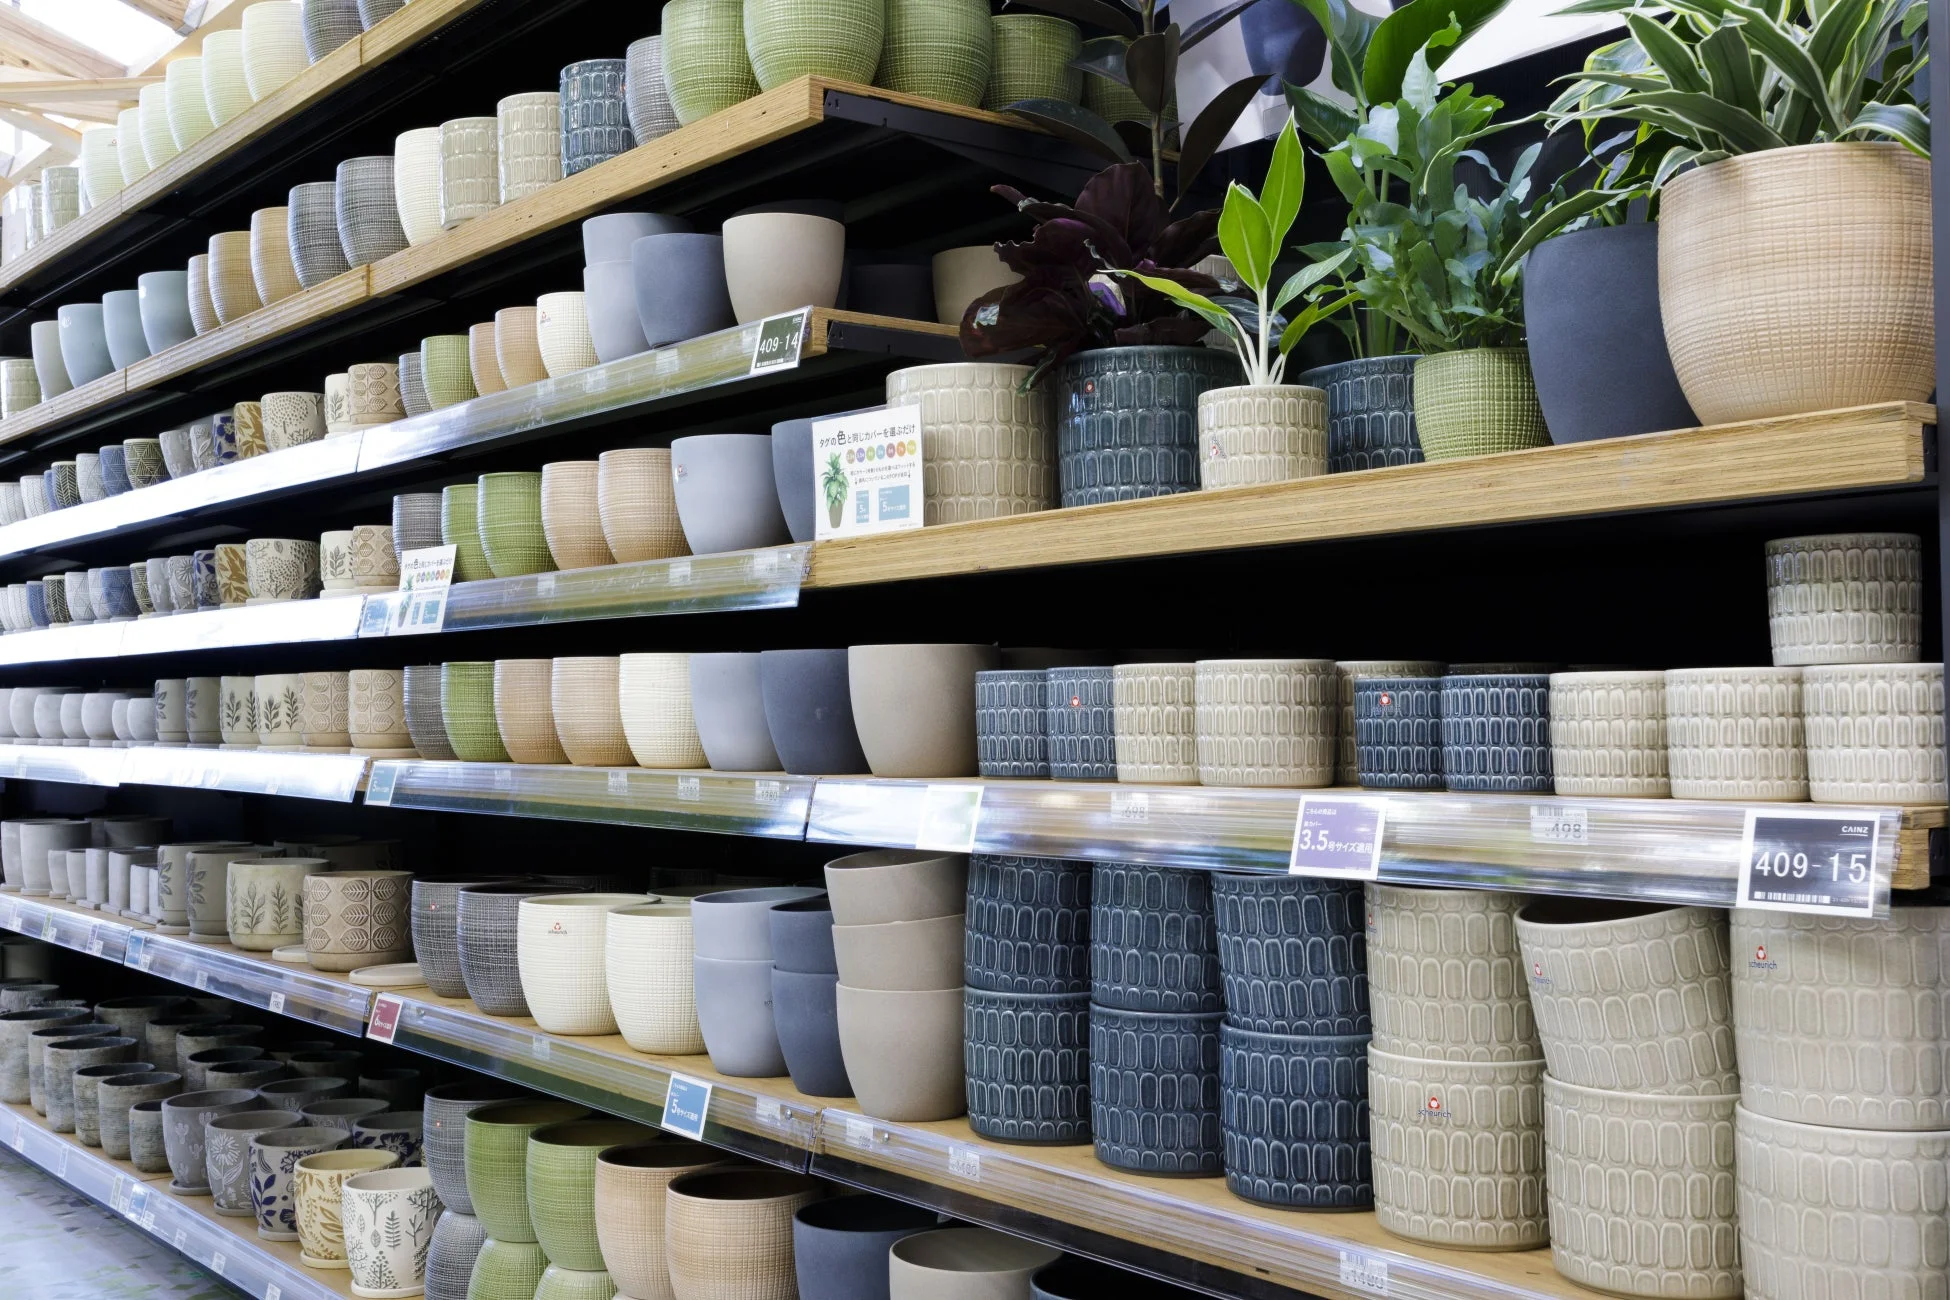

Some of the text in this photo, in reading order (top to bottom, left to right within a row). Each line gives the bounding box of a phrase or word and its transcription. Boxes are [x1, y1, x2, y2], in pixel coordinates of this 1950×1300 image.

[760, 331, 799, 354] 409-14
[819, 423, 916, 448] タグの色と同じカバーを選ぶだけ
[1300, 829, 1373, 854] 3.5号サイズ適用
[1841, 826, 1869, 834] CAINZ
[1755, 852, 1867, 884] 409-15
